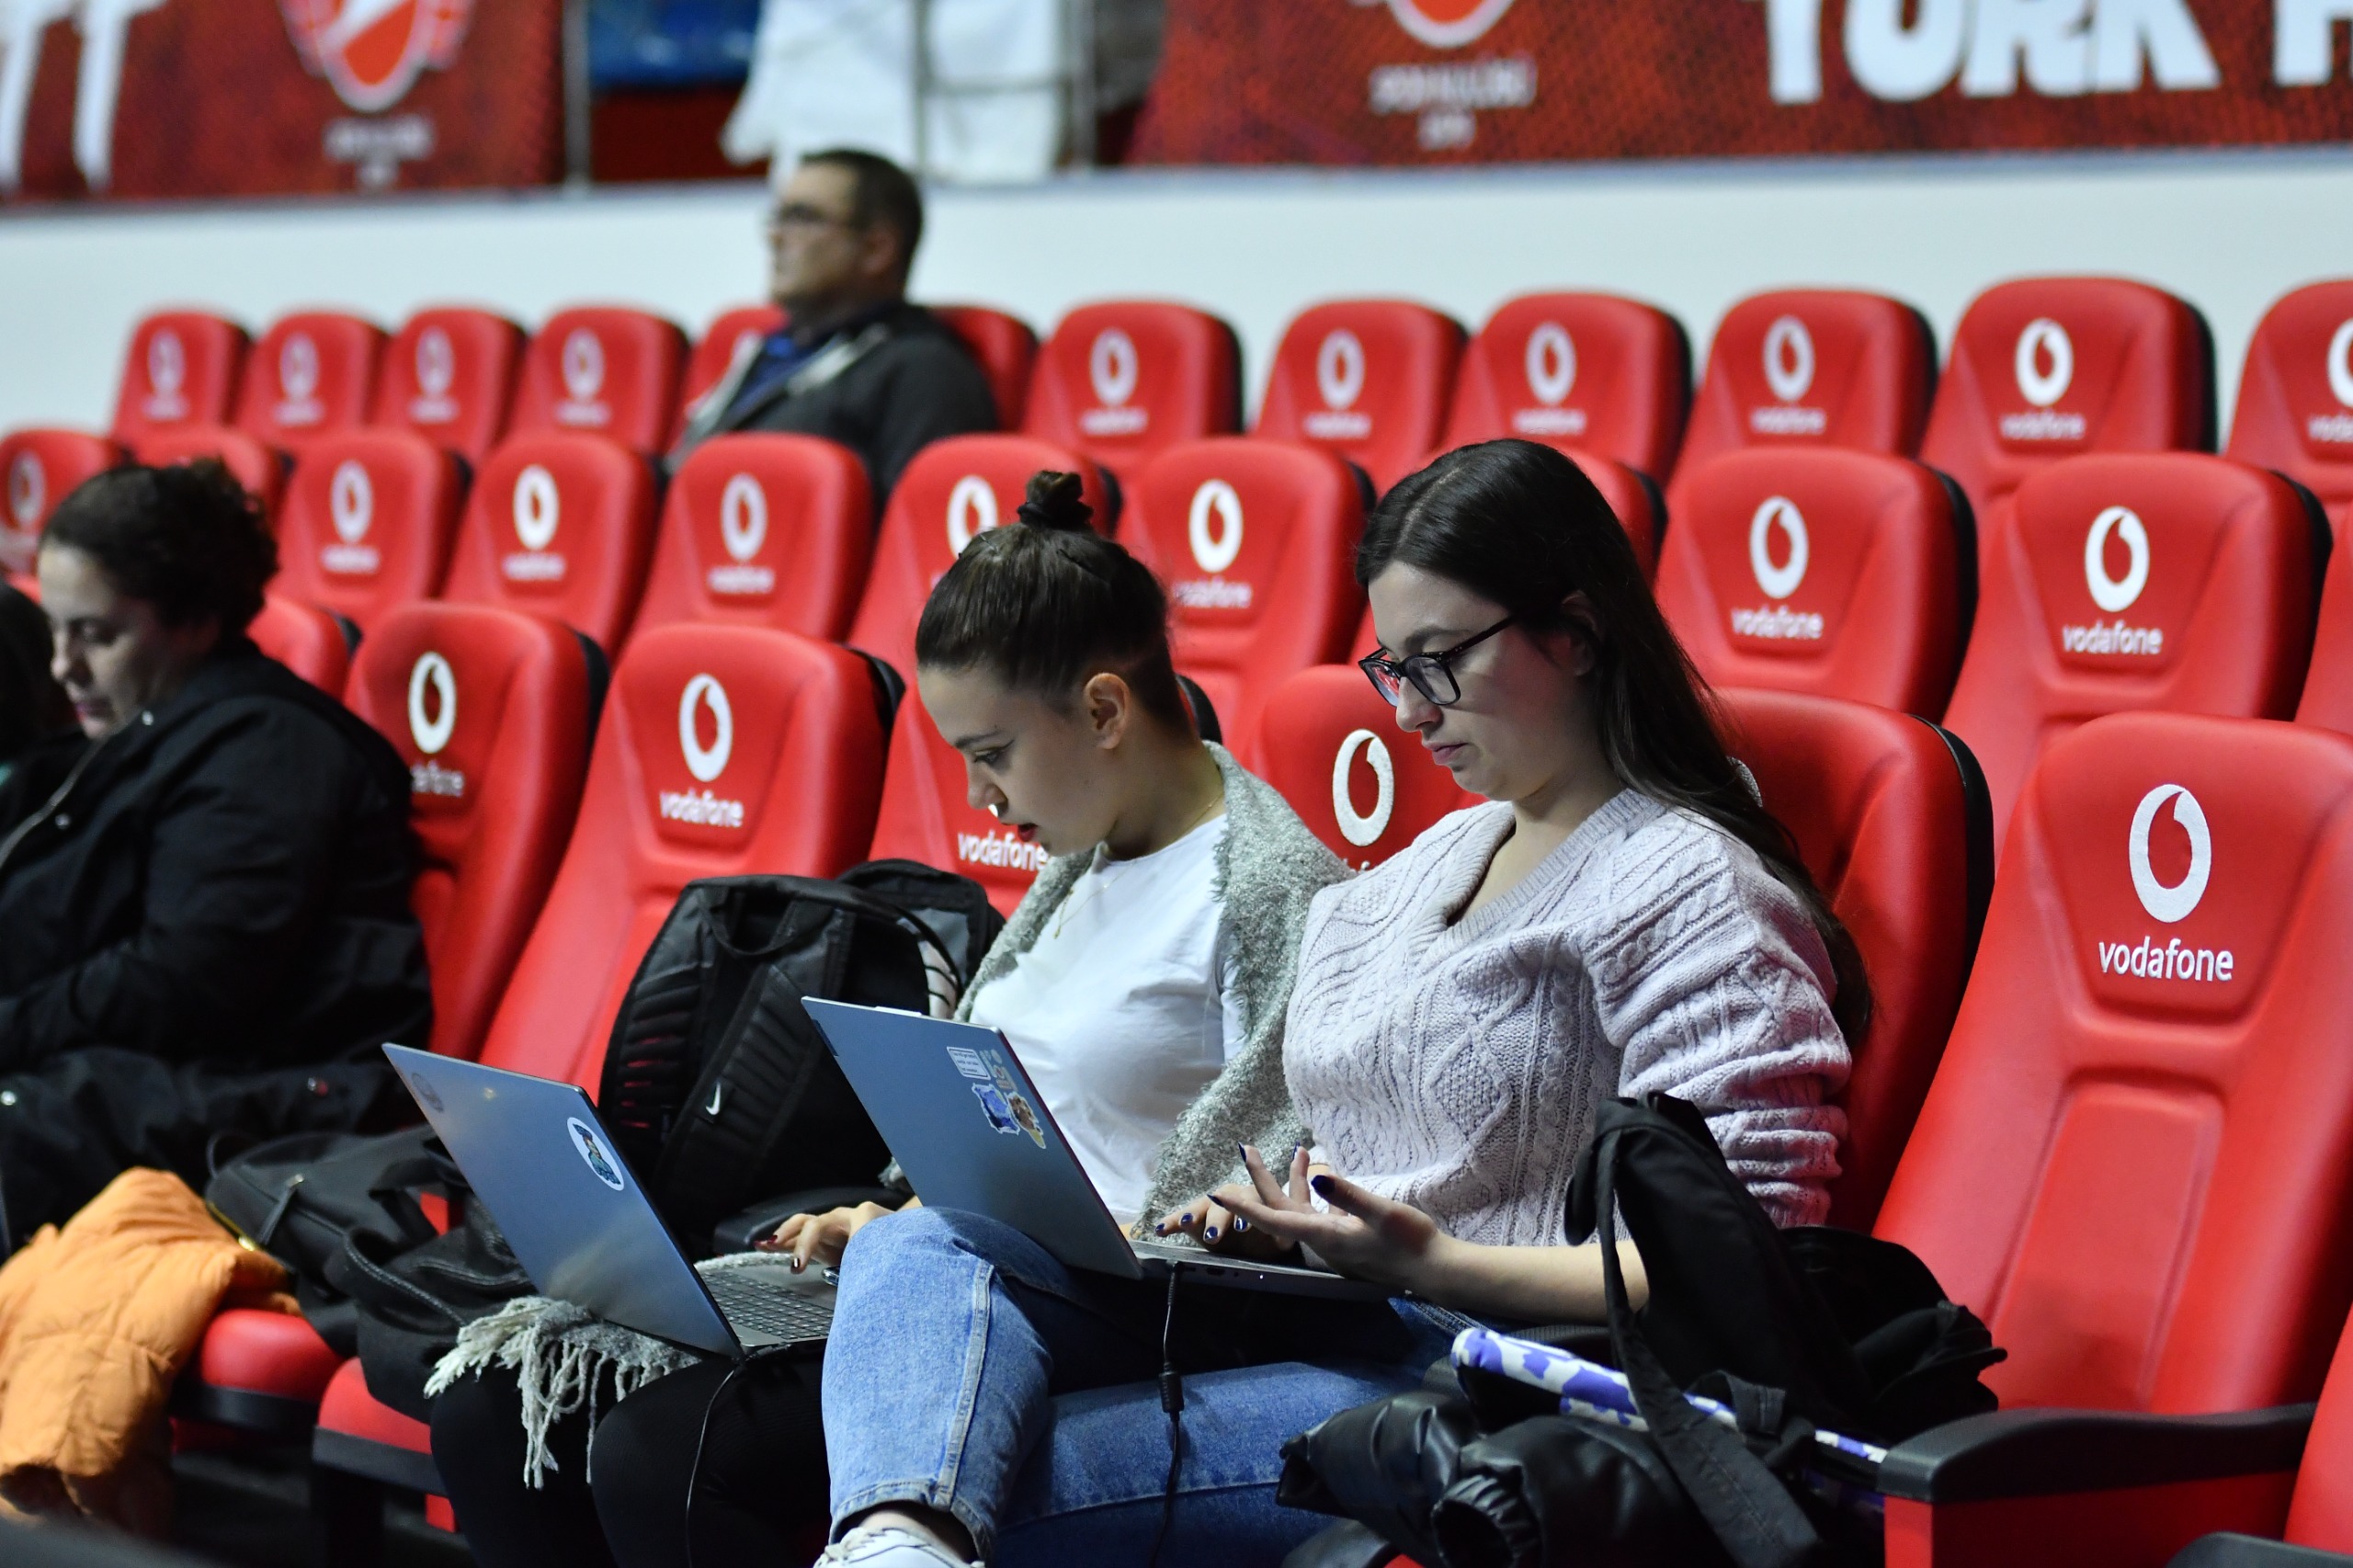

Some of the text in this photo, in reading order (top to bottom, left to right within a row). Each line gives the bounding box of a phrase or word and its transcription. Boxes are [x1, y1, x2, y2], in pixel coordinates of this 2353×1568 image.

[1731, 608, 1824, 641] vodafone
[2062, 621, 2164, 655] vodafone
[412, 760, 465, 797] afone
[660, 789, 744, 829] vodafone
[957, 829, 1049, 871] vodafone
[2099, 936, 2234, 981] vodafone
